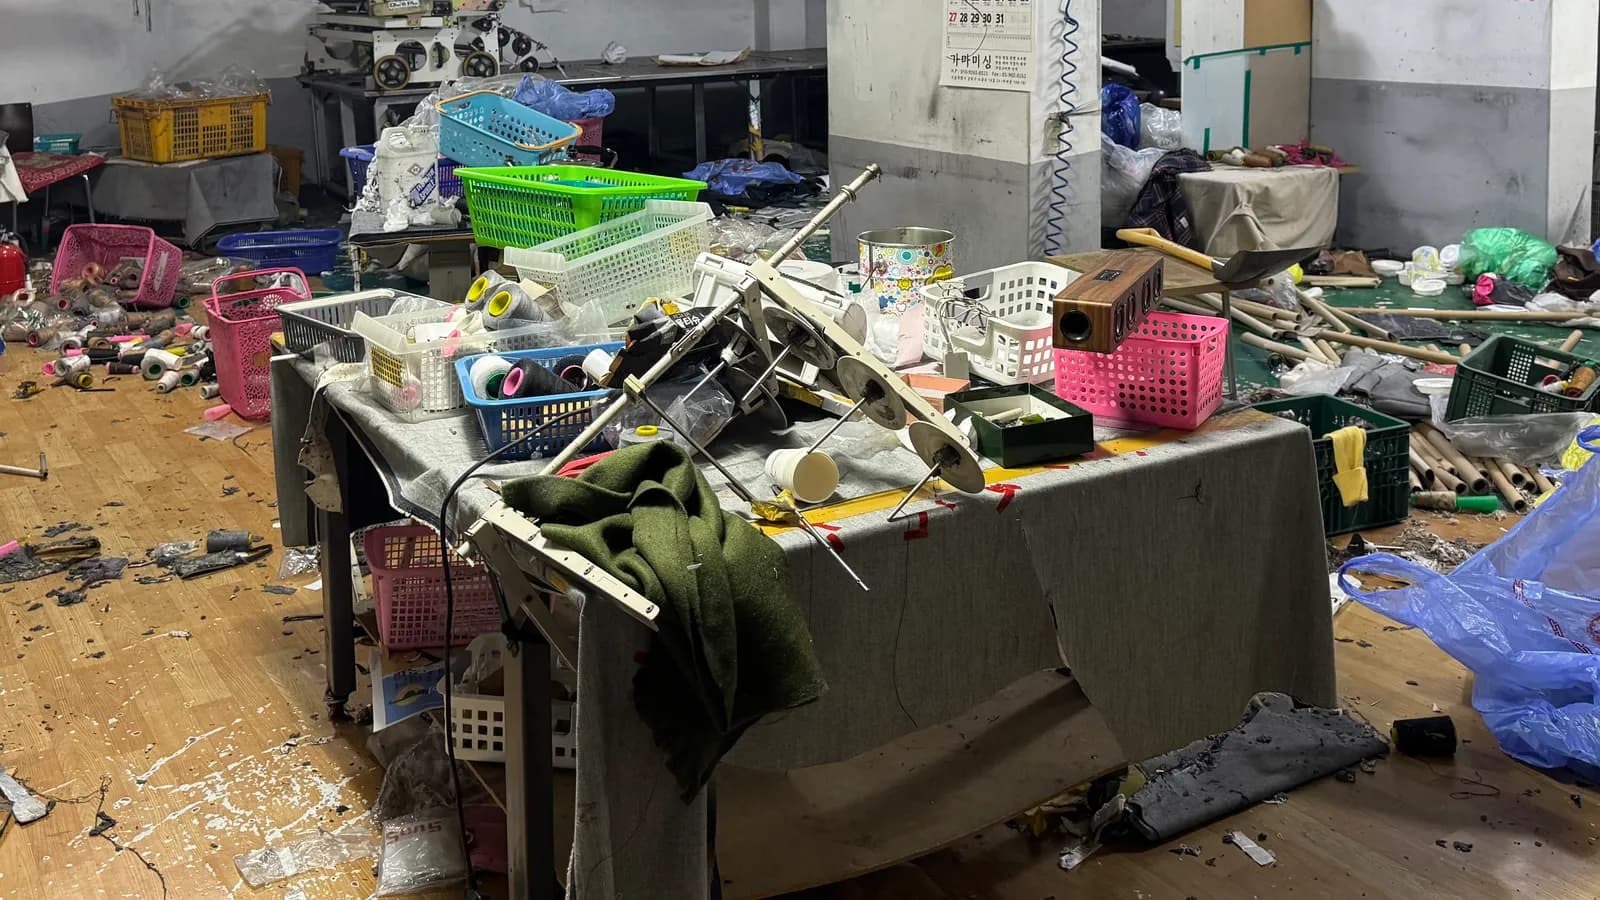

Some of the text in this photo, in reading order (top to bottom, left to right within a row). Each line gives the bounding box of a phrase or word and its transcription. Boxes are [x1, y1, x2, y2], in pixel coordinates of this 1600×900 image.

[949, 12, 957, 22] 27
[960, 13, 968, 23] 28
[971, 13, 979, 23] 29
[983, 13, 991, 24] 30
[996, 14, 1004, 24] 31
